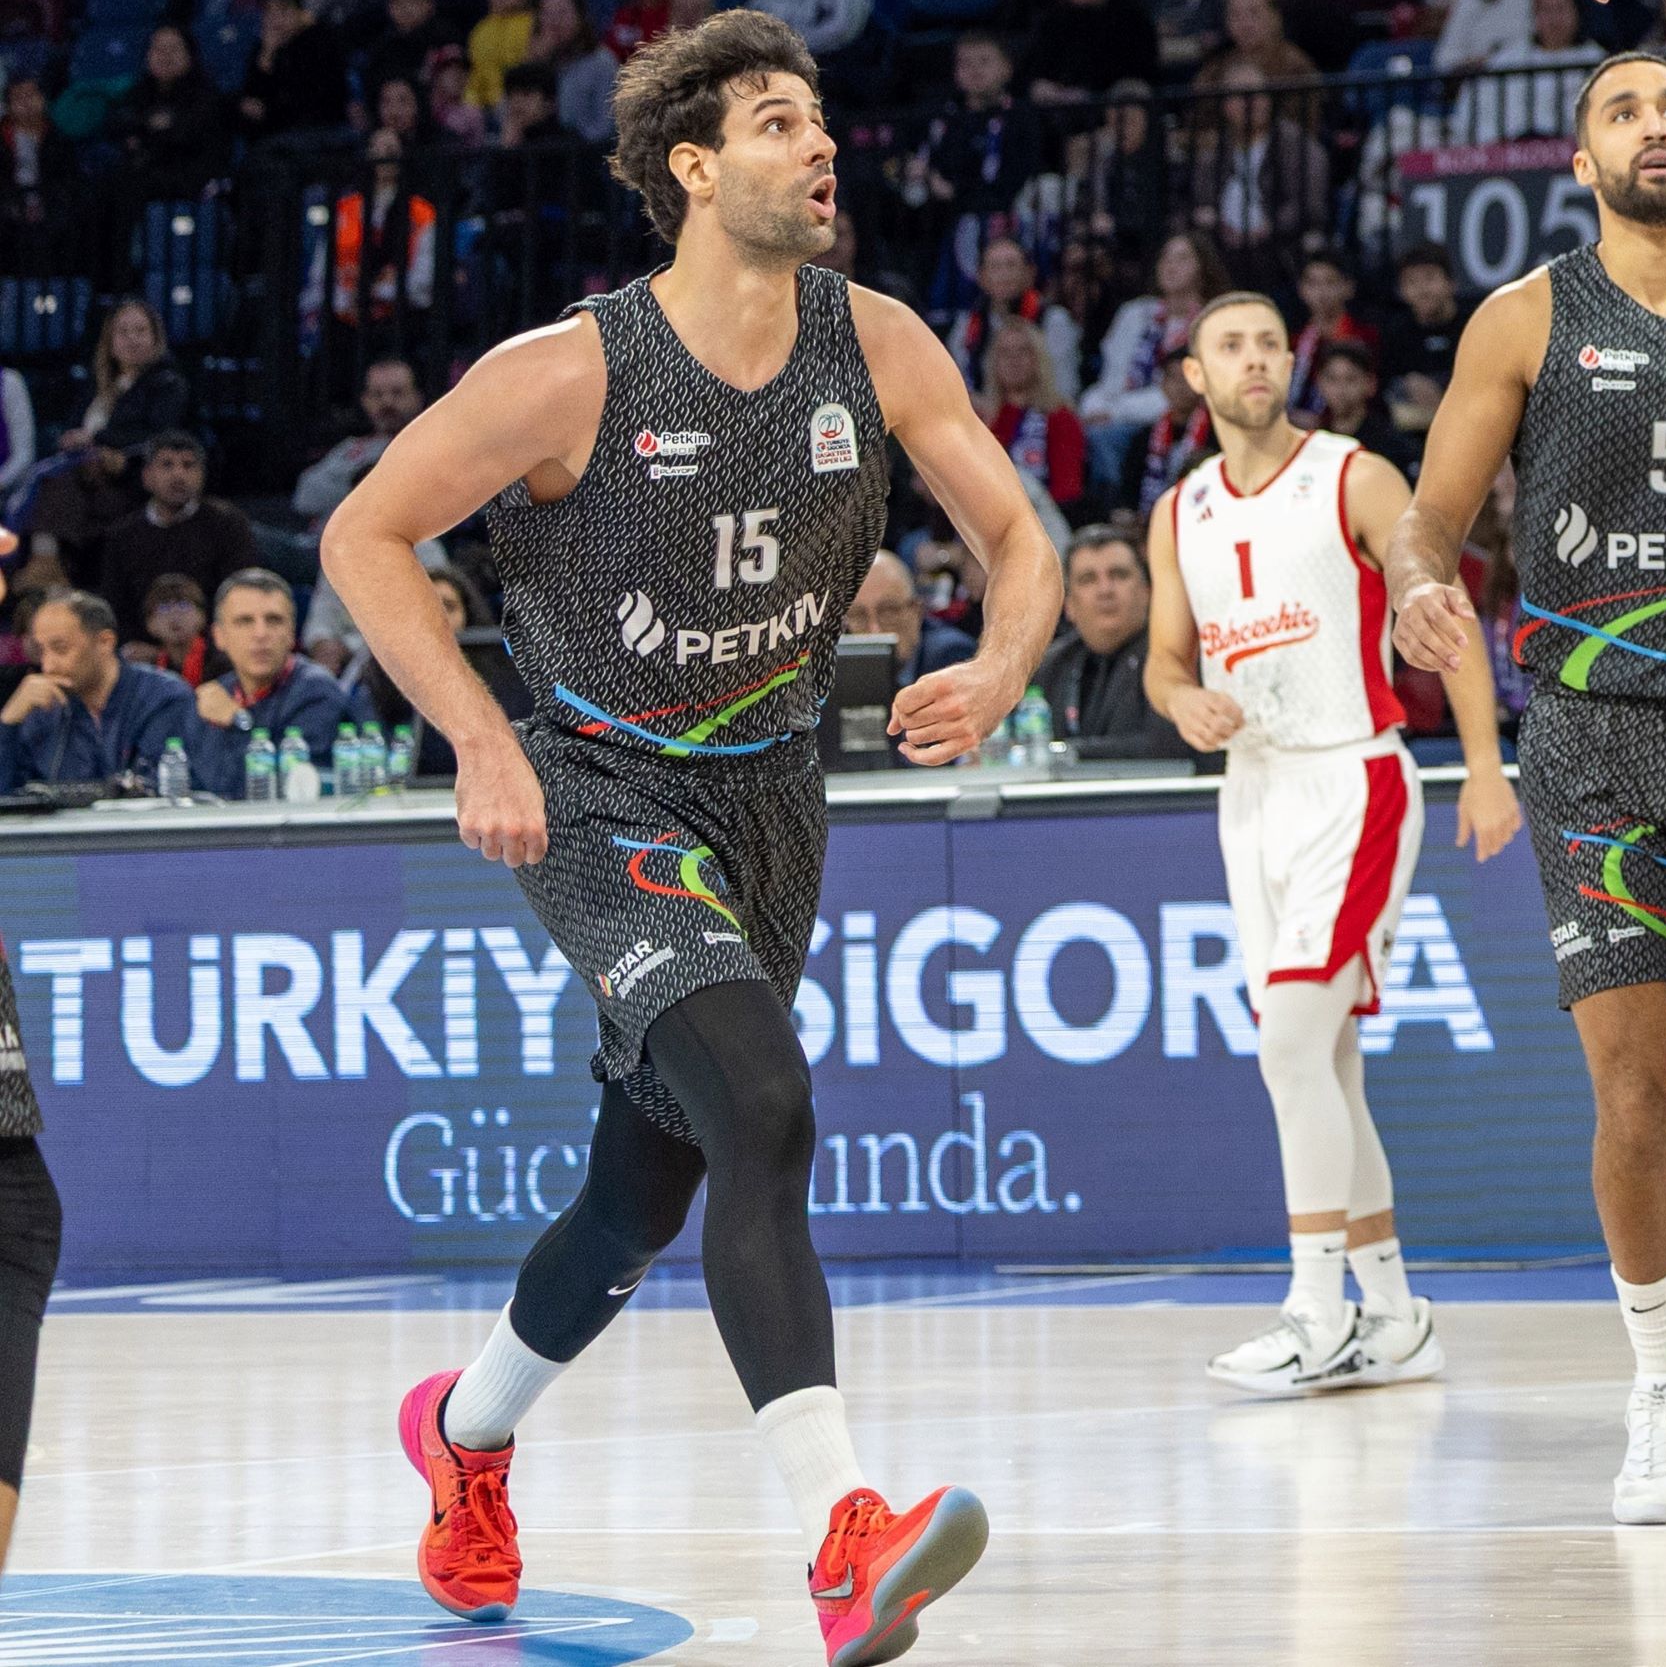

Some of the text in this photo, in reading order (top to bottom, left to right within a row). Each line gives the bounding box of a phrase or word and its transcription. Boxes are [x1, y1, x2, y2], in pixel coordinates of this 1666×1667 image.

[661, 447, 697, 455] SPOR
[662, 432, 710, 445] Petkim
[713, 507, 780, 590] 15
[1234, 541, 1254, 598] 1
[608, 939, 654, 985] STAR
[20, 926, 599, 1086] TÜRKİY
[384, 1108, 600, 1223] Güc
